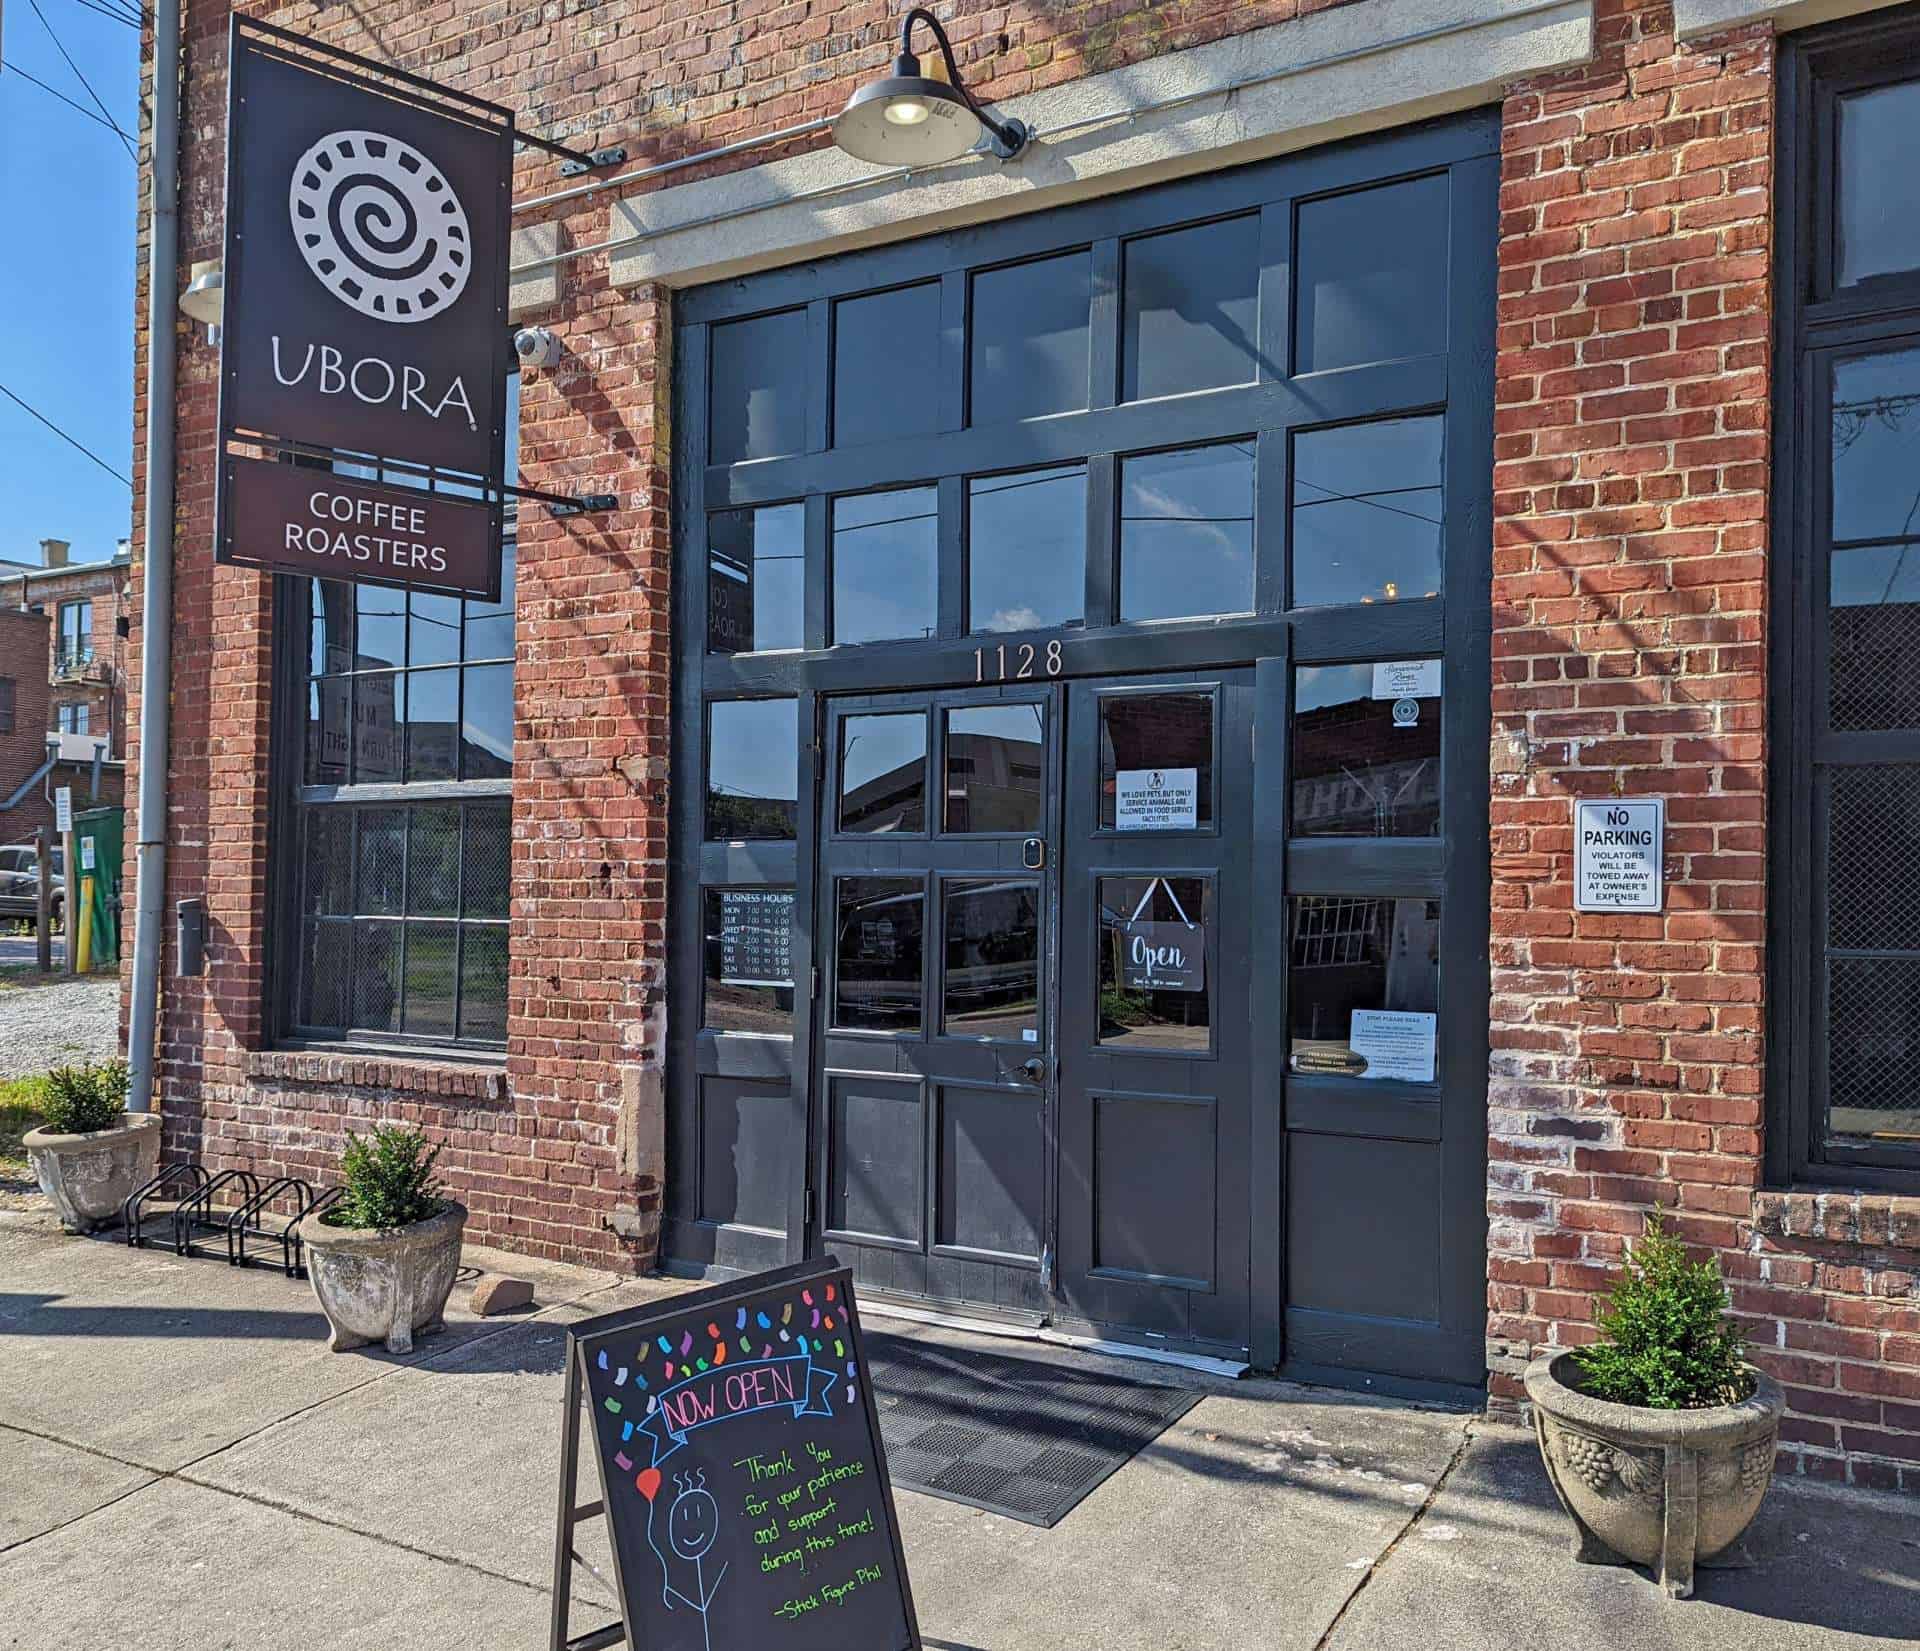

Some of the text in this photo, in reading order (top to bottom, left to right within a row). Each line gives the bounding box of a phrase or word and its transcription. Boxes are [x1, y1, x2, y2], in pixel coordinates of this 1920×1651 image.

[272, 336, 475, 424] UBORA
[310, 492, 426, 534] COFFEE
[285, 523, 447, 572] ROASTERS
[975, 639, 1062, 682] 1128
[1176, 789, 1191, 797] ONLY
[1149, 798, 1175, 806] ANIMALS
[1607, 810, 1629, 825] NO
[1584, 830, 1652, 845] PARKING
[1592, 851, 1645, 860] VIOLATORS
[1599, 862, 1637, 870] WILL BE
[1586, 872, 1650, 880] TOWED AWAY
[1588, 882, 1647, 890] AT OWNER'S
[723, 893, 794, 904] BUSINESS HOURS
[1595, 893, 1640, 901] EXPENSE
[724, 916, 736, 924] TUE
[724, 926, 740, 934] WED
[724, 945, 734, 953] FRI
[724, 955, 735, 963] SAT
[1132, 935, 1186, 977] Open
[724, 965, 738, 974] SUN
[663, 1363, 794, 1431] NOW OPEN
[733, 1441, 832, 1482] Thank You
[745, 1461, 864, 1516] for your patience
[754, 1497, 837, 1544] and support
[761, 1508, 875, 1572] during this time!
[821, 1584, 855, 1606] Figure
[856, 1564, 881, 1585] Phil
